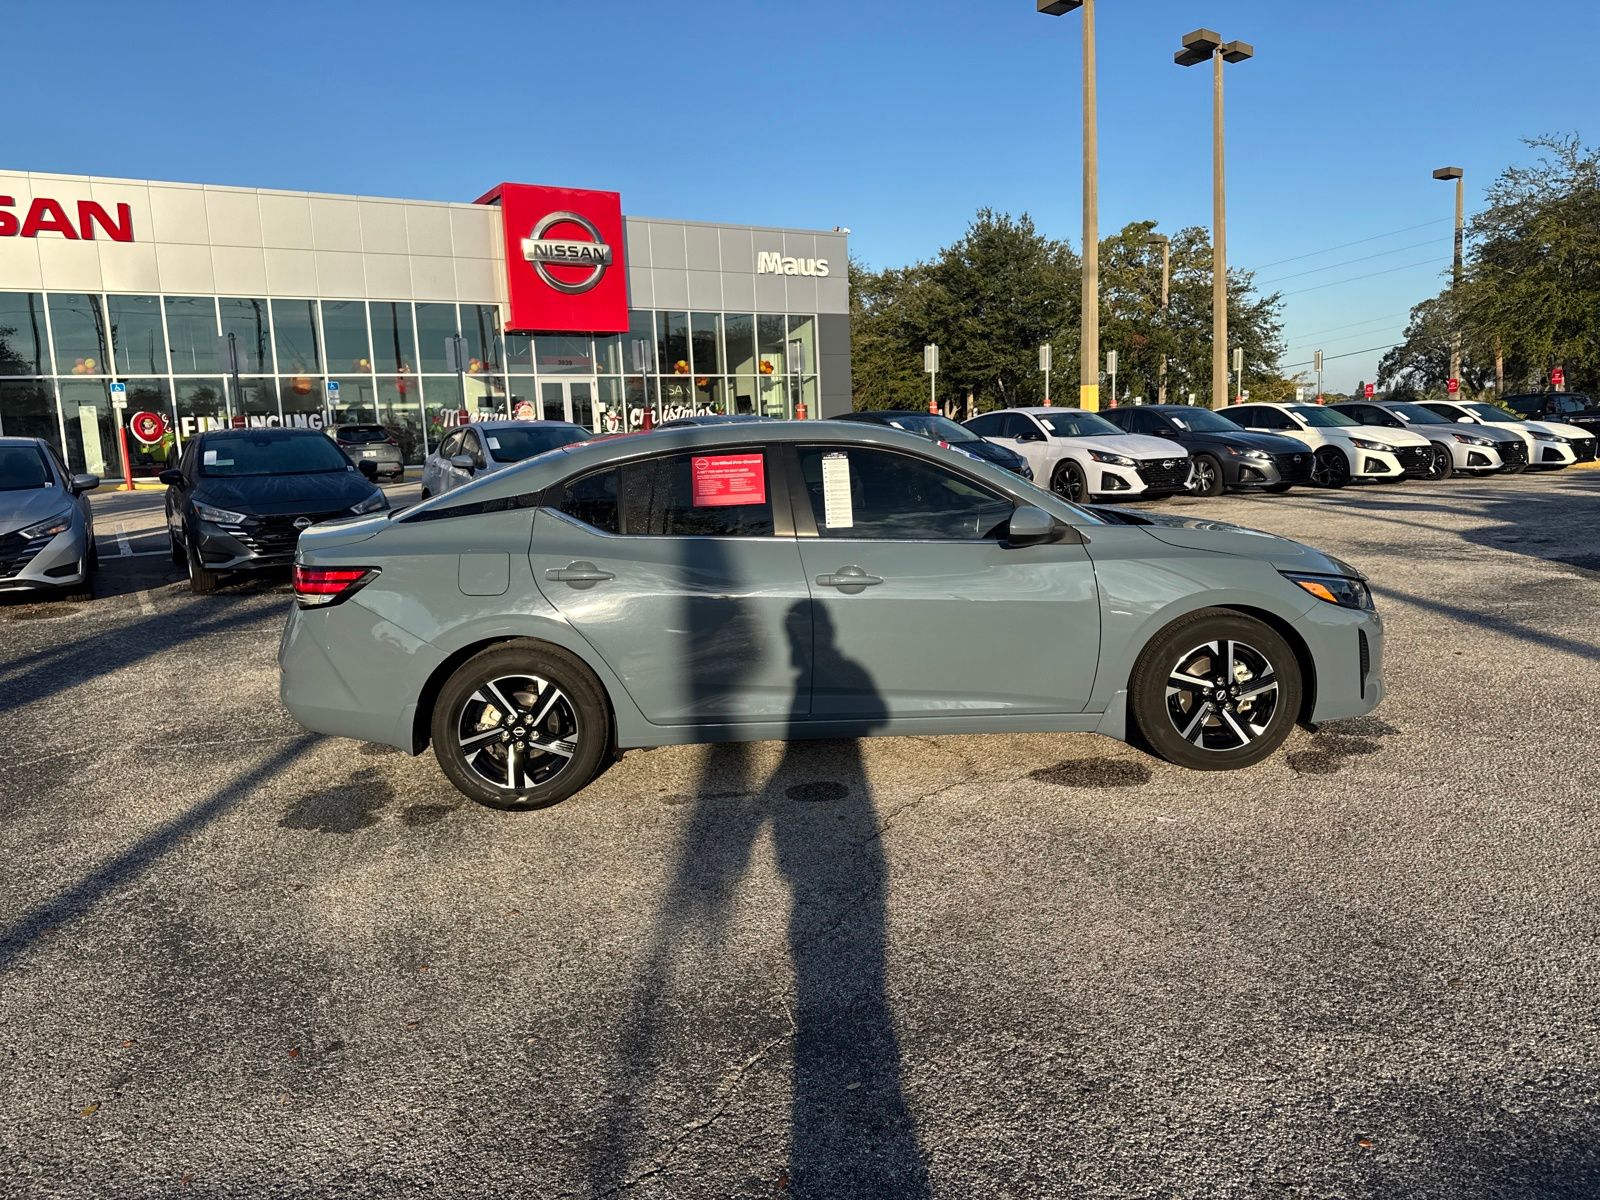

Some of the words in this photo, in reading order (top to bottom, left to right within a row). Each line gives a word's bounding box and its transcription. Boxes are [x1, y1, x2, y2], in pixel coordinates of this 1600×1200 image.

[533, 244, 604, 260] NISSAN
[757, 251, 829, 277] Maus
[181, 410, 328, 437] FINNCING!
